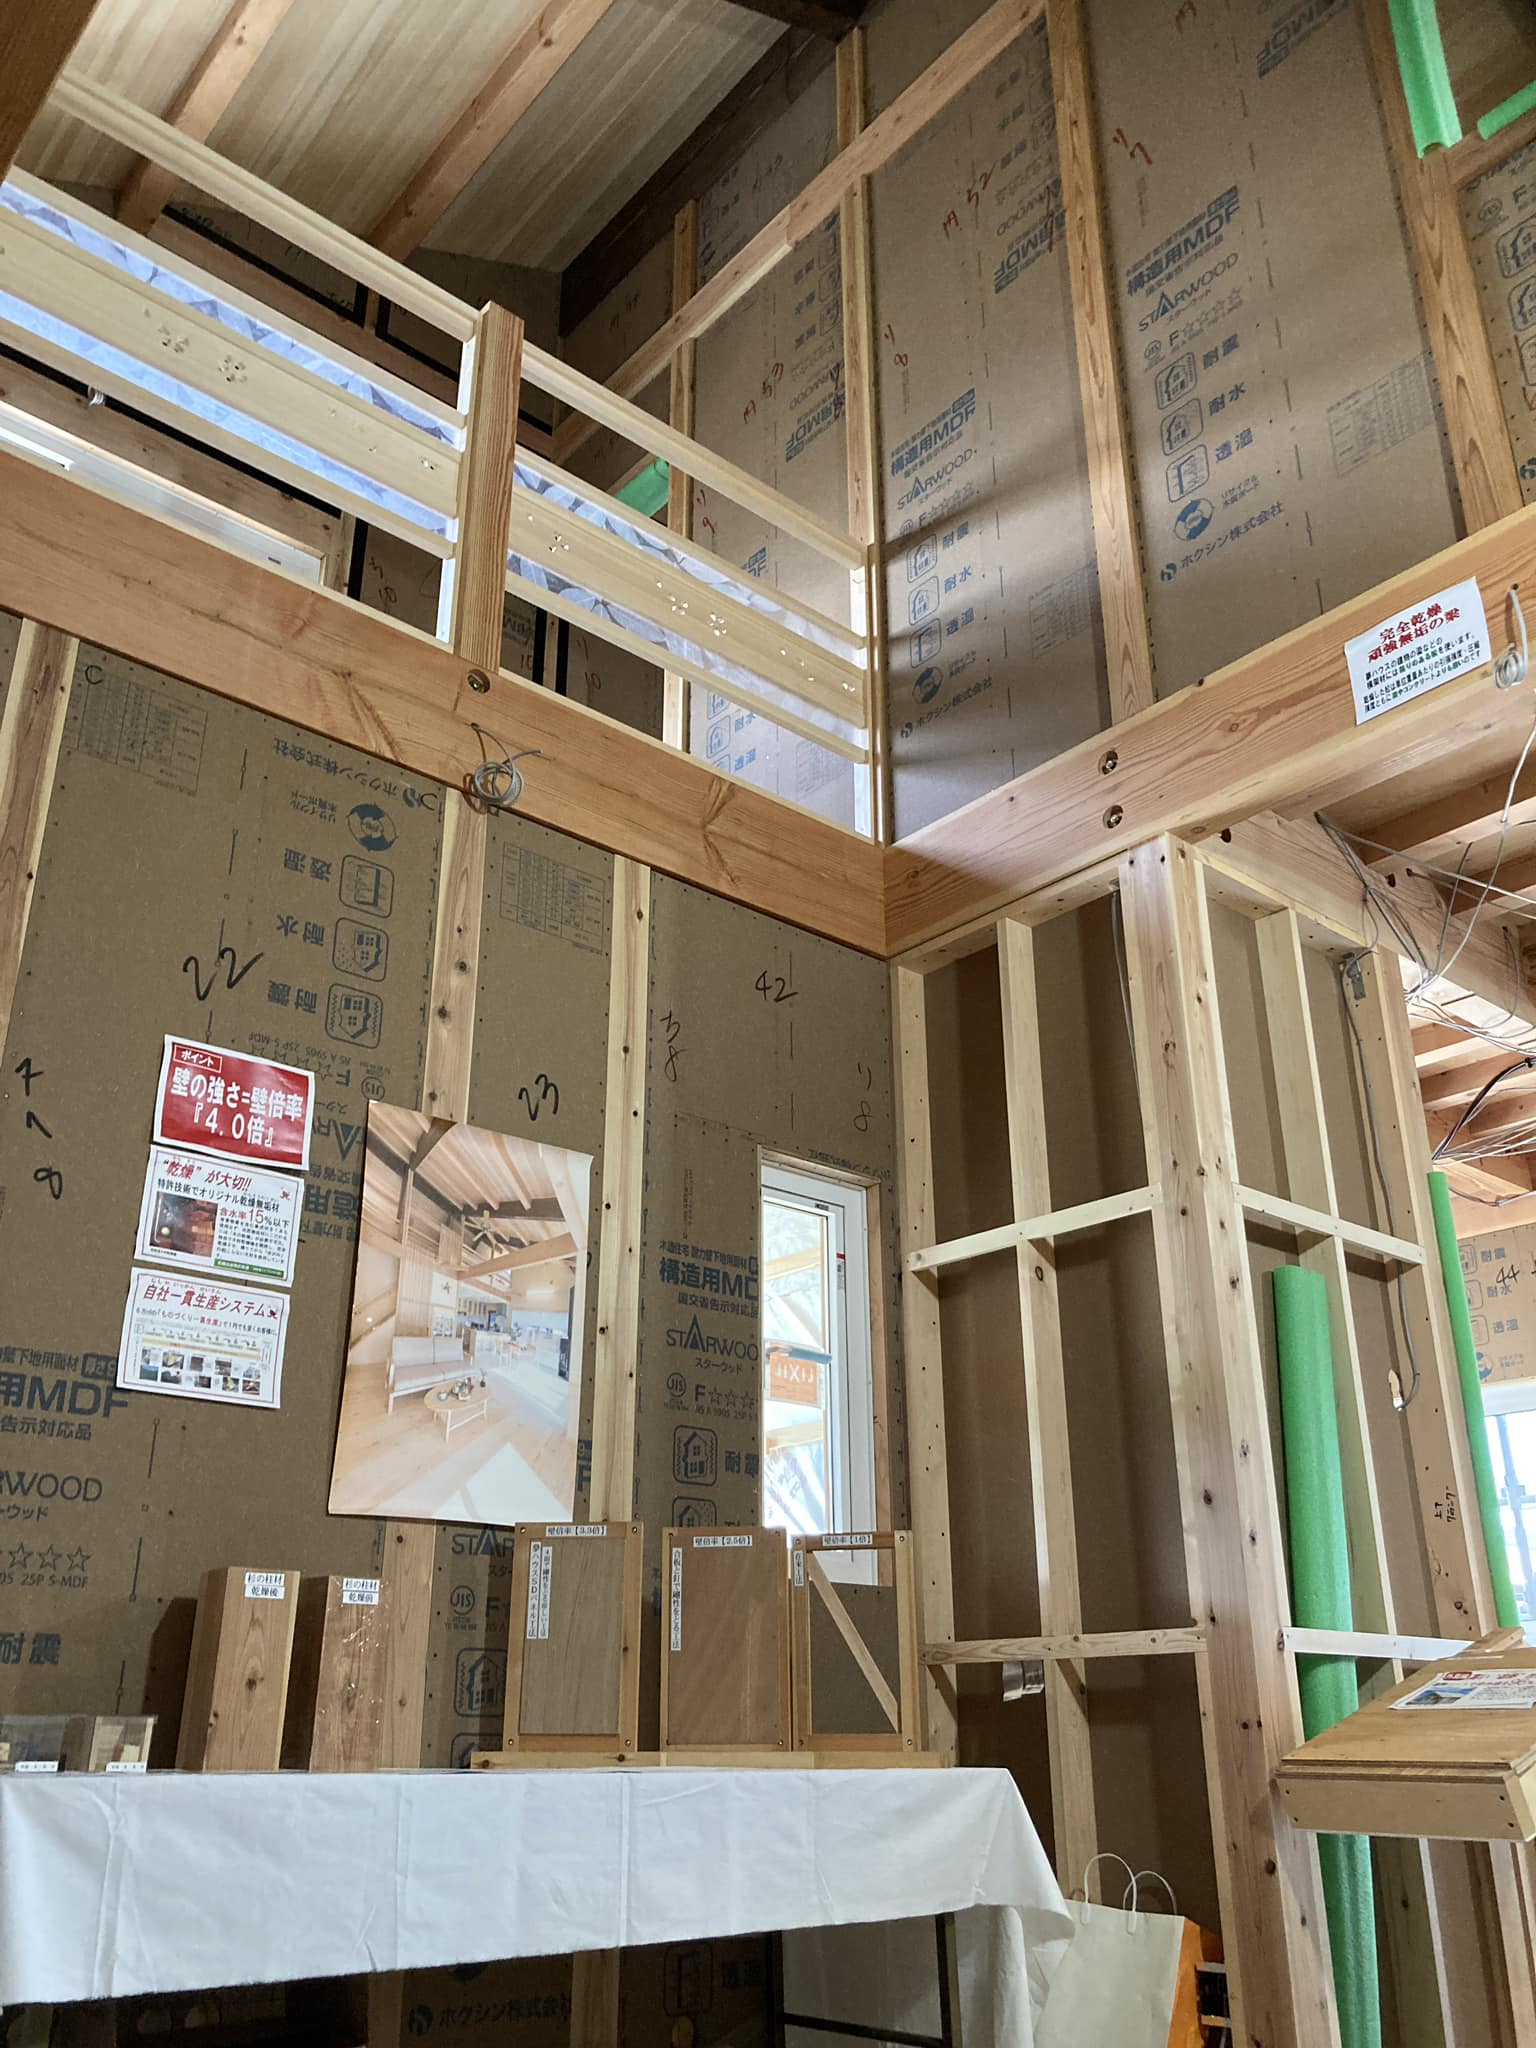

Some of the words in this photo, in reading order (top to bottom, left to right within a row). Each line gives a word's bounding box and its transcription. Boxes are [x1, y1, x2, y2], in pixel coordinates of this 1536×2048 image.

[1138, 252, 1239, 332] STARWOOD
[1209, 385, 1247, 415] 耐水
[897, 448, 974, 511] STARWOOD
[1181, 501, 1284, 569] ホクシン株式会社
[944, 564, 973, 594] 耐水
[1379, 602, 1444, 643] 完全乾燥
[273, 737, 398, 798] ホクシン株式会社
[275, 914, 326, 947] 耐水
[182, 946, 265, 1001] 22
[755, 970, 799, 1003] 42
[181, 1049, 215, 1068] ポイント
[518, 1073, 560, 1122] 23
[143, 1283, 266, 1319] 自社一貫生産システム
